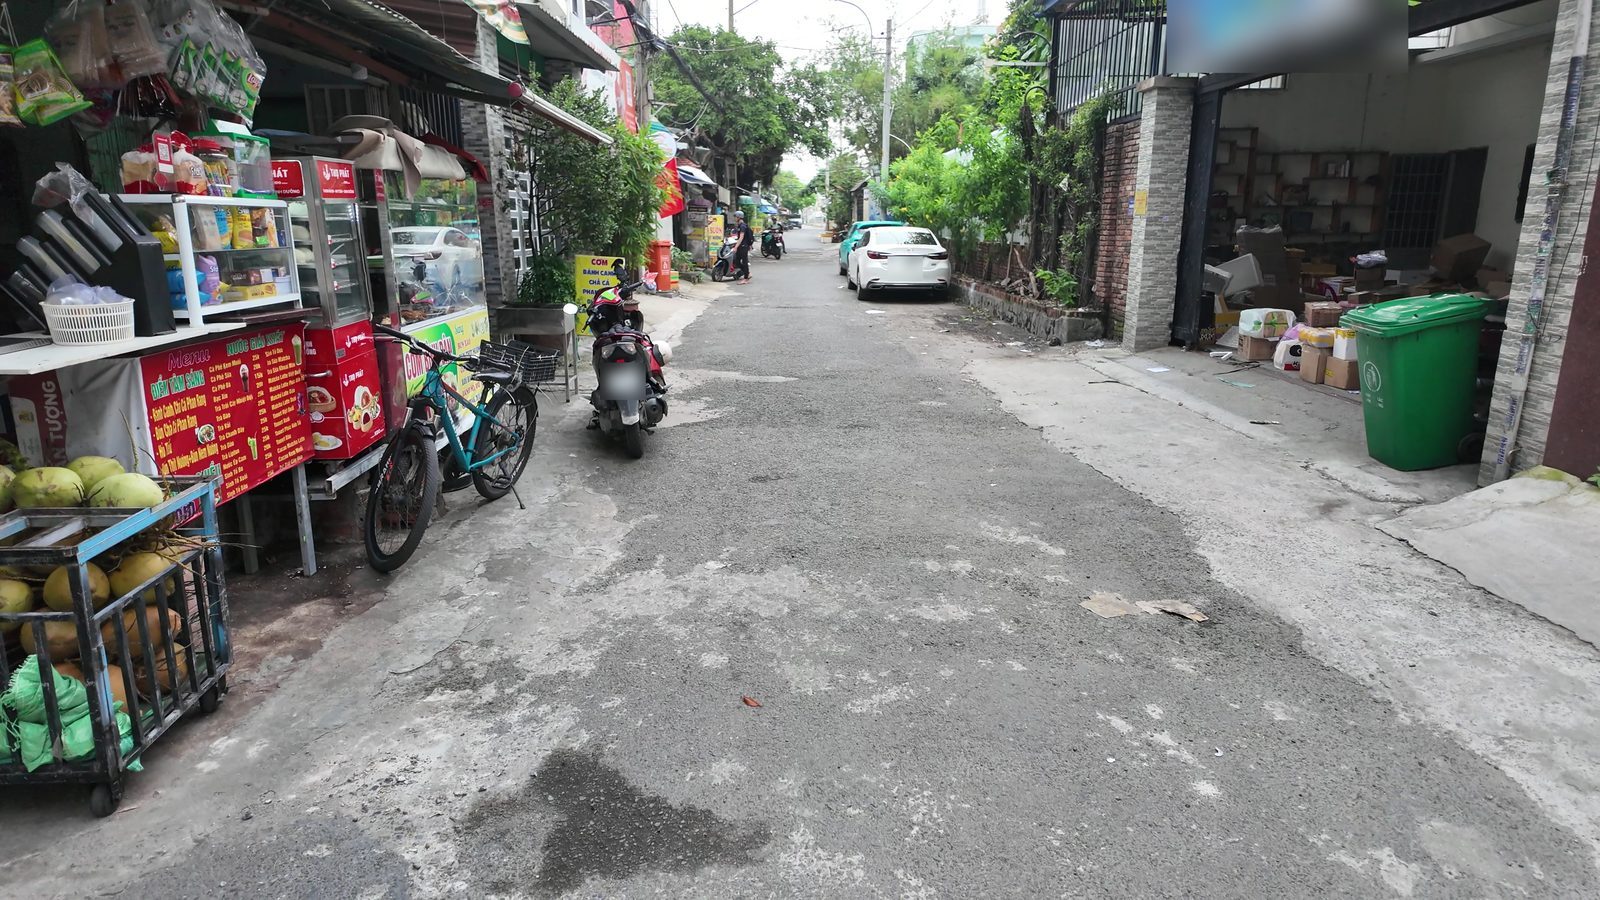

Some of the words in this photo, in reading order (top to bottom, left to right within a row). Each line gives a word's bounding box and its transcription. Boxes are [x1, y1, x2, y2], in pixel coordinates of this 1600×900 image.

[272, 167, 288, 178] HÁT
[226, 338, 249, 356] NƯỚC
[168, 349, 210, 371] Menu
[185, 368, 206, 389] SÁNG
